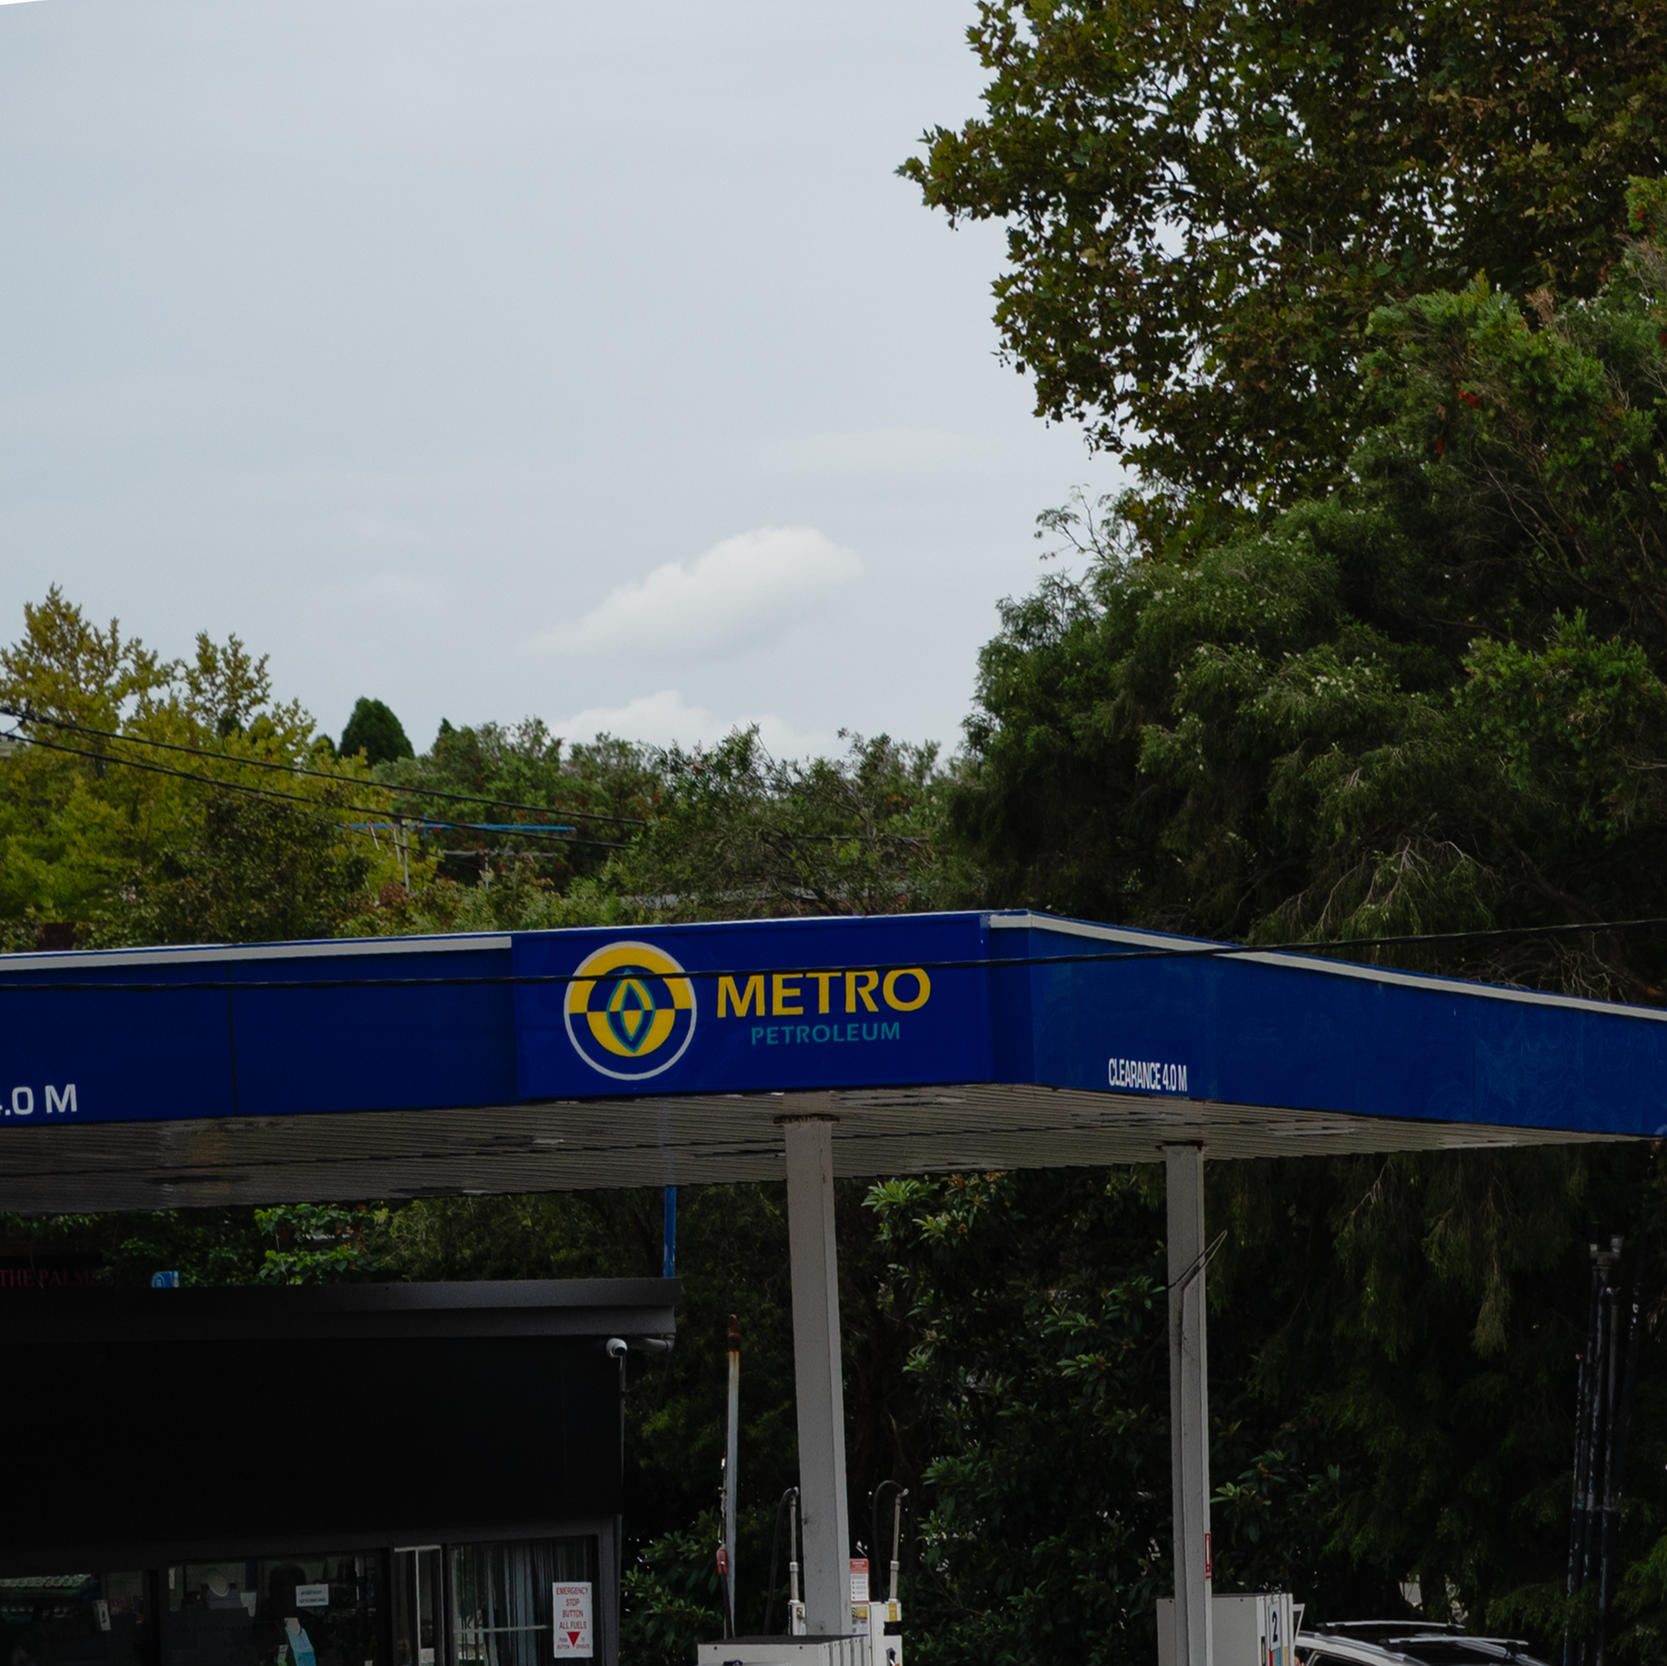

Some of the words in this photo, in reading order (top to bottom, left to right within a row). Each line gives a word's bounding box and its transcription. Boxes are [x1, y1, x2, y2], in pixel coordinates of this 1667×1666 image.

[716, 967, 931, 1018] METRO
[751, 1021, 901, 1046] PETROLEUM
[1108, 1057, 1161, 1090] CLEARANCE
[1178, 1064, 1188, 1092] M
[0, 1086, 34, 1116] .0
[44, 1083, 78, 1114] M
[556, 1586, 588, 1596] EMERGENCY
[565, 1598, 580, 1607] STOP
[559, 1621, 569, 1630] ALL
[570, 1621, 587, 1629] FUELS
[562, 1609, 584, 1618] BUTTON
[1271, 1611, 1279, 1643] 2
